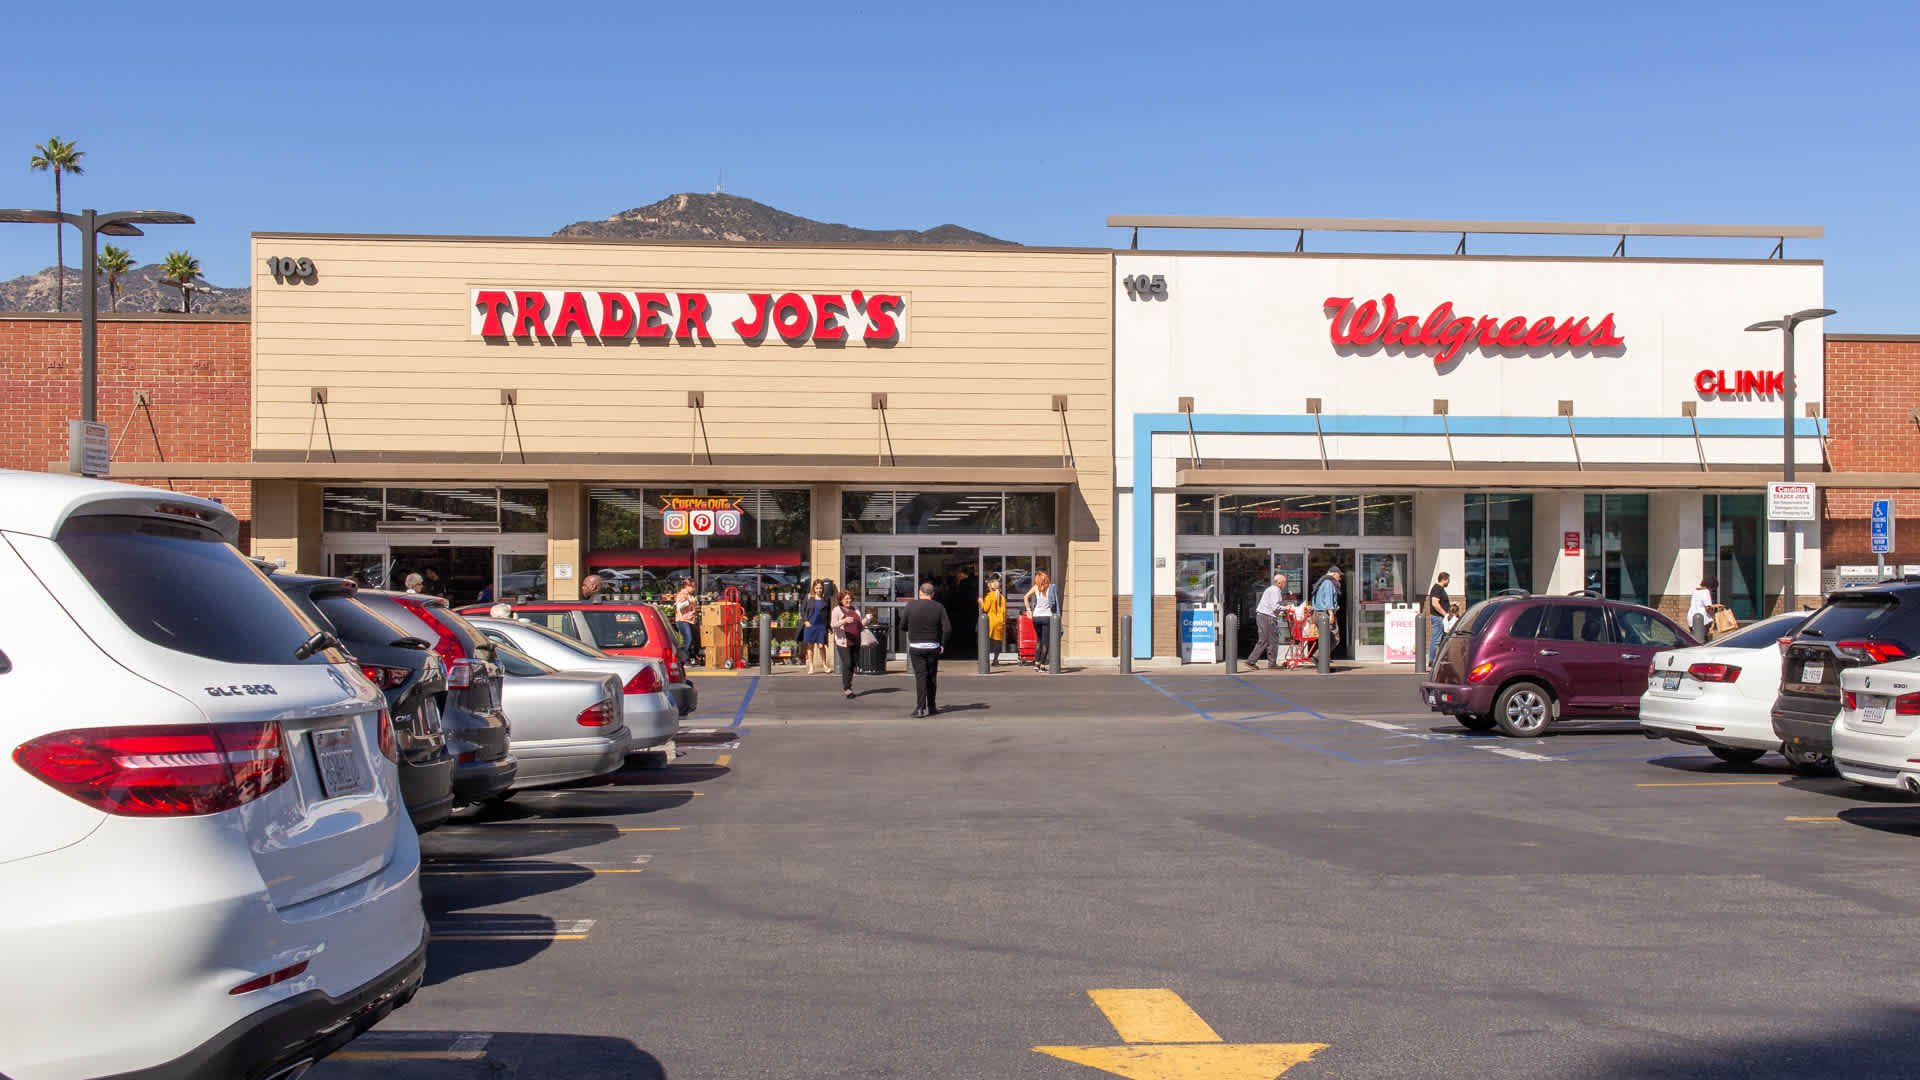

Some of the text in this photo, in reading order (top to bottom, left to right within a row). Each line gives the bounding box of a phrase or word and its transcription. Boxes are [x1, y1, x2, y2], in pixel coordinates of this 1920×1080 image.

[266, 256, 313, 276] 103
[1123, 274, 1167, 292] 105
[476, 289, 903, 340] TRADER JOE'S
[1323, 293, 1626, 364] Walgreens
[1279, 523, 1301, 534] 105
[1183, 619, 1212, 628] Coming
